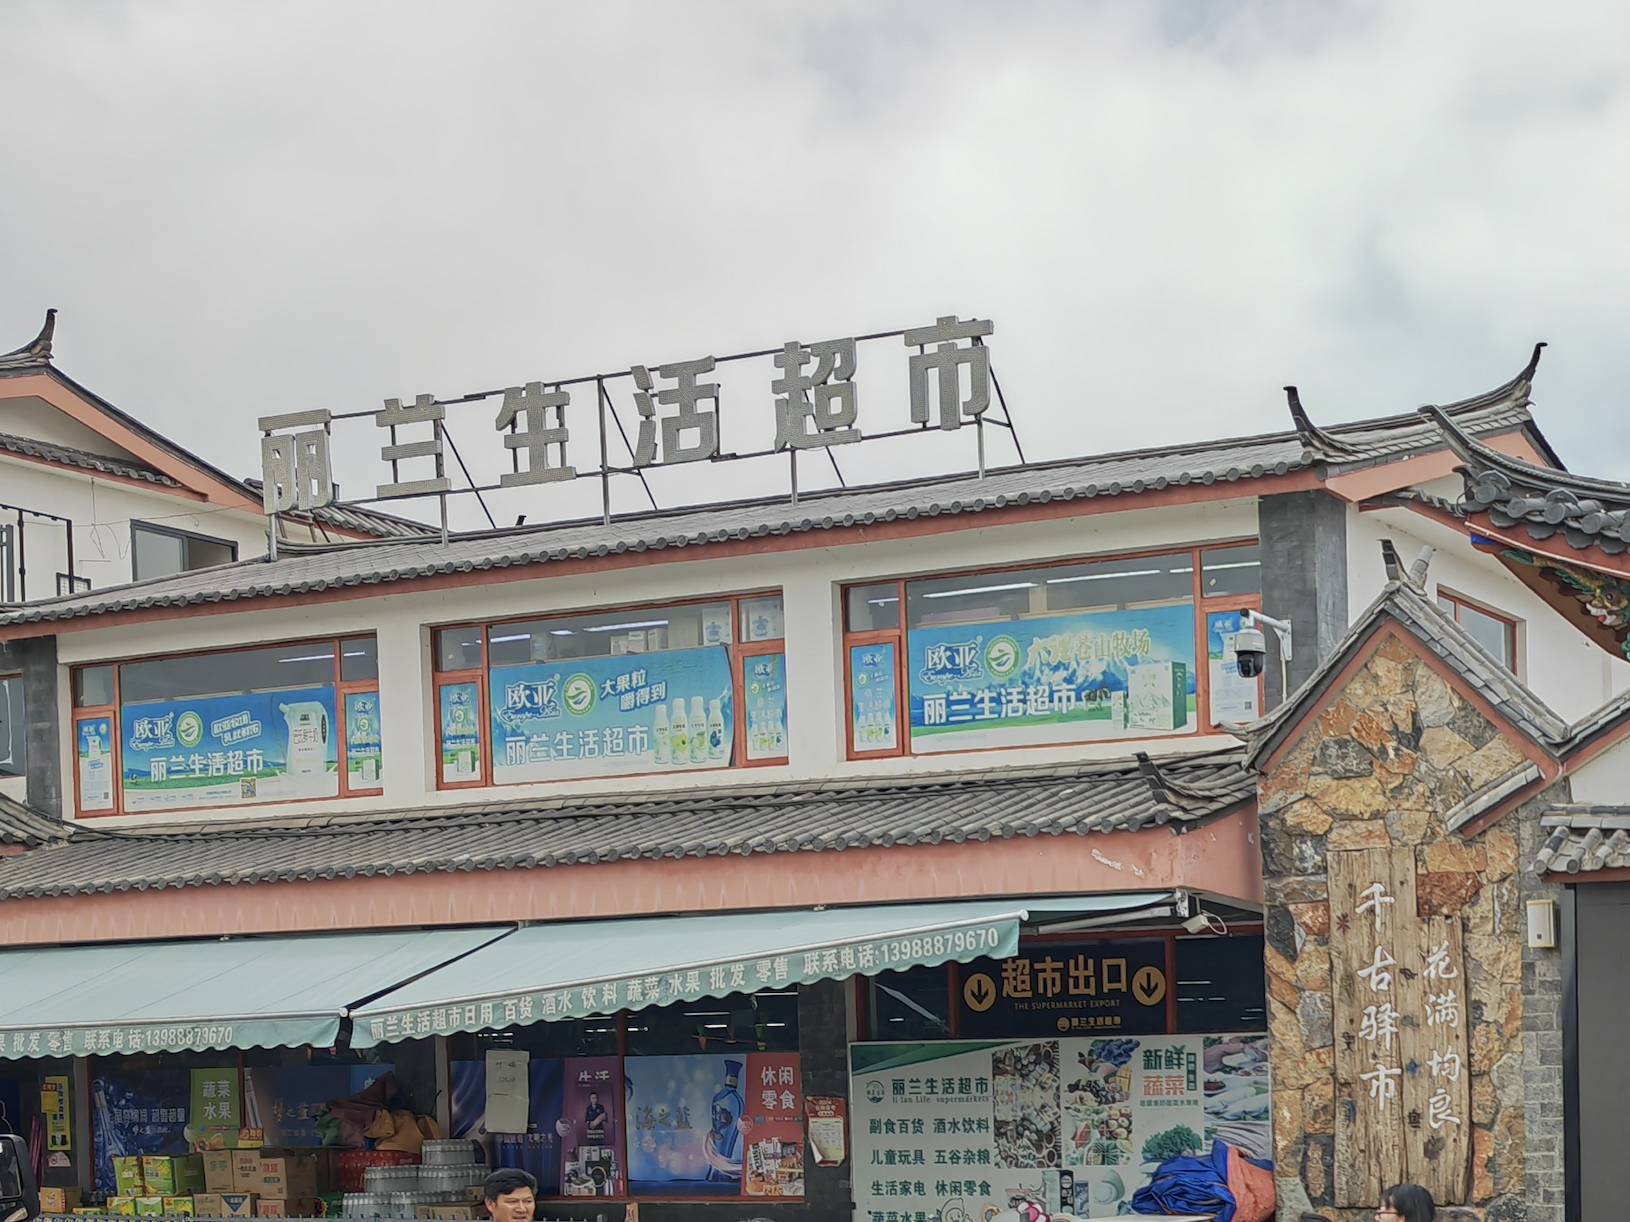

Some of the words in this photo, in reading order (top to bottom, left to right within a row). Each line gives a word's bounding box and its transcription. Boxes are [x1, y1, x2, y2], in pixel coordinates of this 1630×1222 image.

[258, 315, 994, 515] 丽兰生活超市
[926, 643, 978, 670] 欧亚
[1027, 629, 1151, 665] 大理苍山牧场
[506, 682, 556, 709] 欧亚
[600, 669, 647, 697] 大果粒
[619, 682, 667, 711] 嚼得到
[923, 684, 1076, 726] 丽兰生活超市
[132, 718, 170, 740] 欧亚
[505, 725, 650, 766] 丽兰生活超市
[150, 749, 264, 783] 丽兰生活超市
[503, 997, 533, 1021] 百货
[541, 991, 572, 1014] 酒水
[581, 983, 618, 1008] 饮料
[626, 975, 660, 1002] 蔬菜
[669, 970, 701, 996] 水果
[709, 963, 745, 989] 批发
[754, 956, 790, 982] 零售
[1001, 954, 1128, 998] 超市出口
[1031, 1001, 1087, 1010] SUPERMARKET
[1090, 1000, 1120, 1008] EXPORT
[1355, 882, 1401, 1111] 千古驿市
[12, 1032, 40, 1053] 批发
[47, 1031, 73, 1051] 零售
[1422, 940, 1462, 1129] 花满均良
[1142, 1045, 1185, 1070] 新鲜
[203, 1080, 232, 1097] 蔬菜
[761, 1065, 794, 1086] 休闲
[891, 1077, 989, 1096] 丽兰生活超市
[1143, 1075, 1185, 1095] 蔬菜
[203, 1102, 232, 1120] 水果
[762, 1089, 795, 1110] 零食
[869, 1118, 925, 1134] 副食百货
[933, 1117, 990, 1134] 酒水饮料
[870, 1150, 925, 1165] 儿童玩具
[934, 1149, 991, 1165] 五谷杂粮
[871, 1180, 926, 1196] 生活家电
[935, 1180, 991, 1196] 休闲零食
